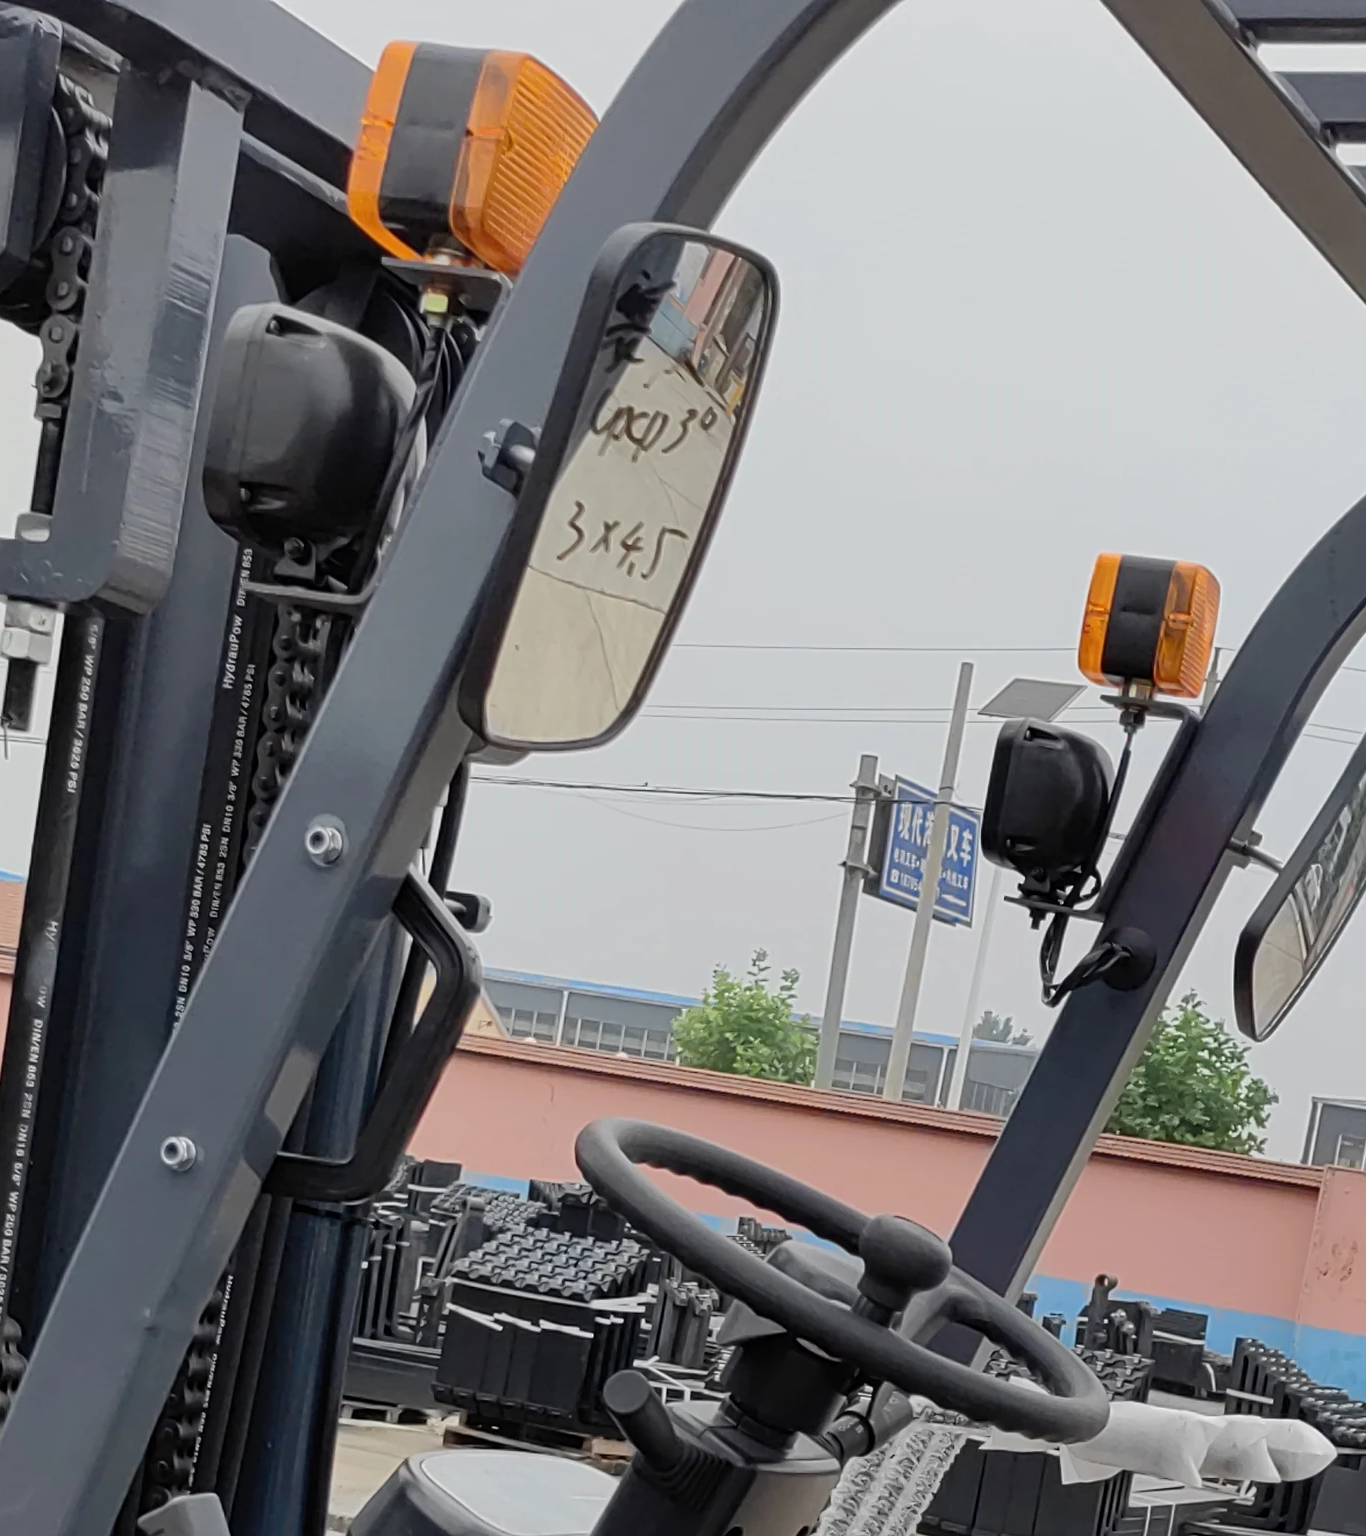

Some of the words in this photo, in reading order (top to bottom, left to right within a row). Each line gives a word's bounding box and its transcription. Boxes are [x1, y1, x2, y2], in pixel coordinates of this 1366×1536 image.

[84, 655, 95, 676] WP
[223, 616, 243, 689] HydrauPow
[237, 716, 247, 738] BAR
[245, 664, 256, 682] PSI
[76, 703, 88, 729] BAR
[67, 771, 78, 794] PSI
[187, 919, 197, 937] WP
[193, 876, 204, 897] BAR
[201, 824, 211, 841] PSI
[29, 1019, 43, 1064] DIN/EN
[8, 1191, 19, 1212] WP
[0, 1239, 13, 1264] BAR
